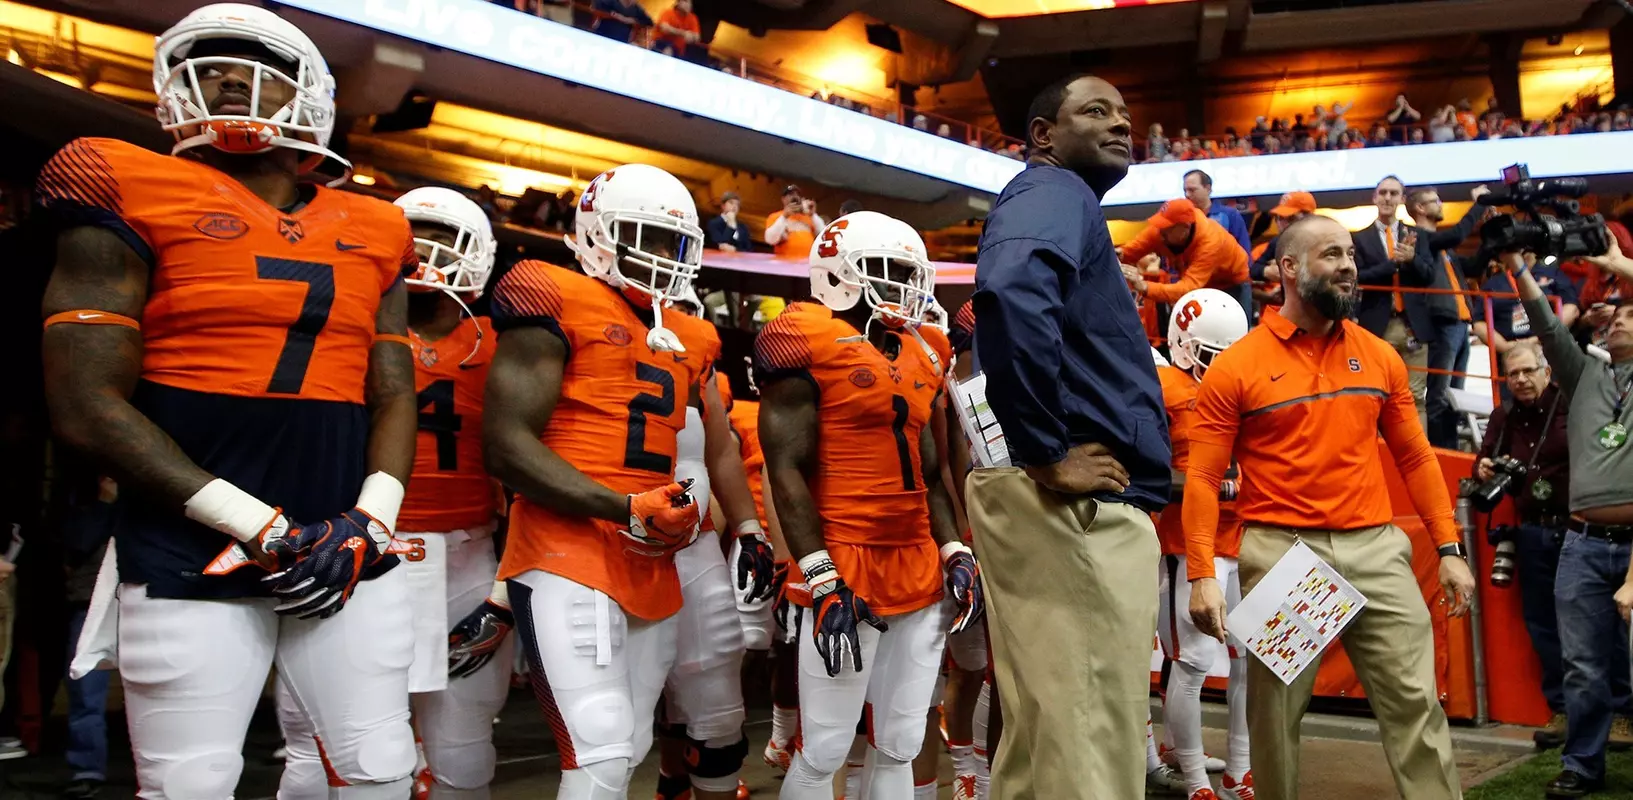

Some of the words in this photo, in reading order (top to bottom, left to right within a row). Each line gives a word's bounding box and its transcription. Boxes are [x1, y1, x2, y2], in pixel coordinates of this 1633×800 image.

[365, 0, 494, 46] Live
[203, 218, 241, 232] ACC
[818, 220, 849, 258] S
[255, 255, 335, 394] 7
[1175, 299, 1202, 331] S
[1348, 358, 1362, 372] S
[416, 379, 463, 471] 4
[623, 361, 676, 475] 2
[892, 394, 916, 490] 1
